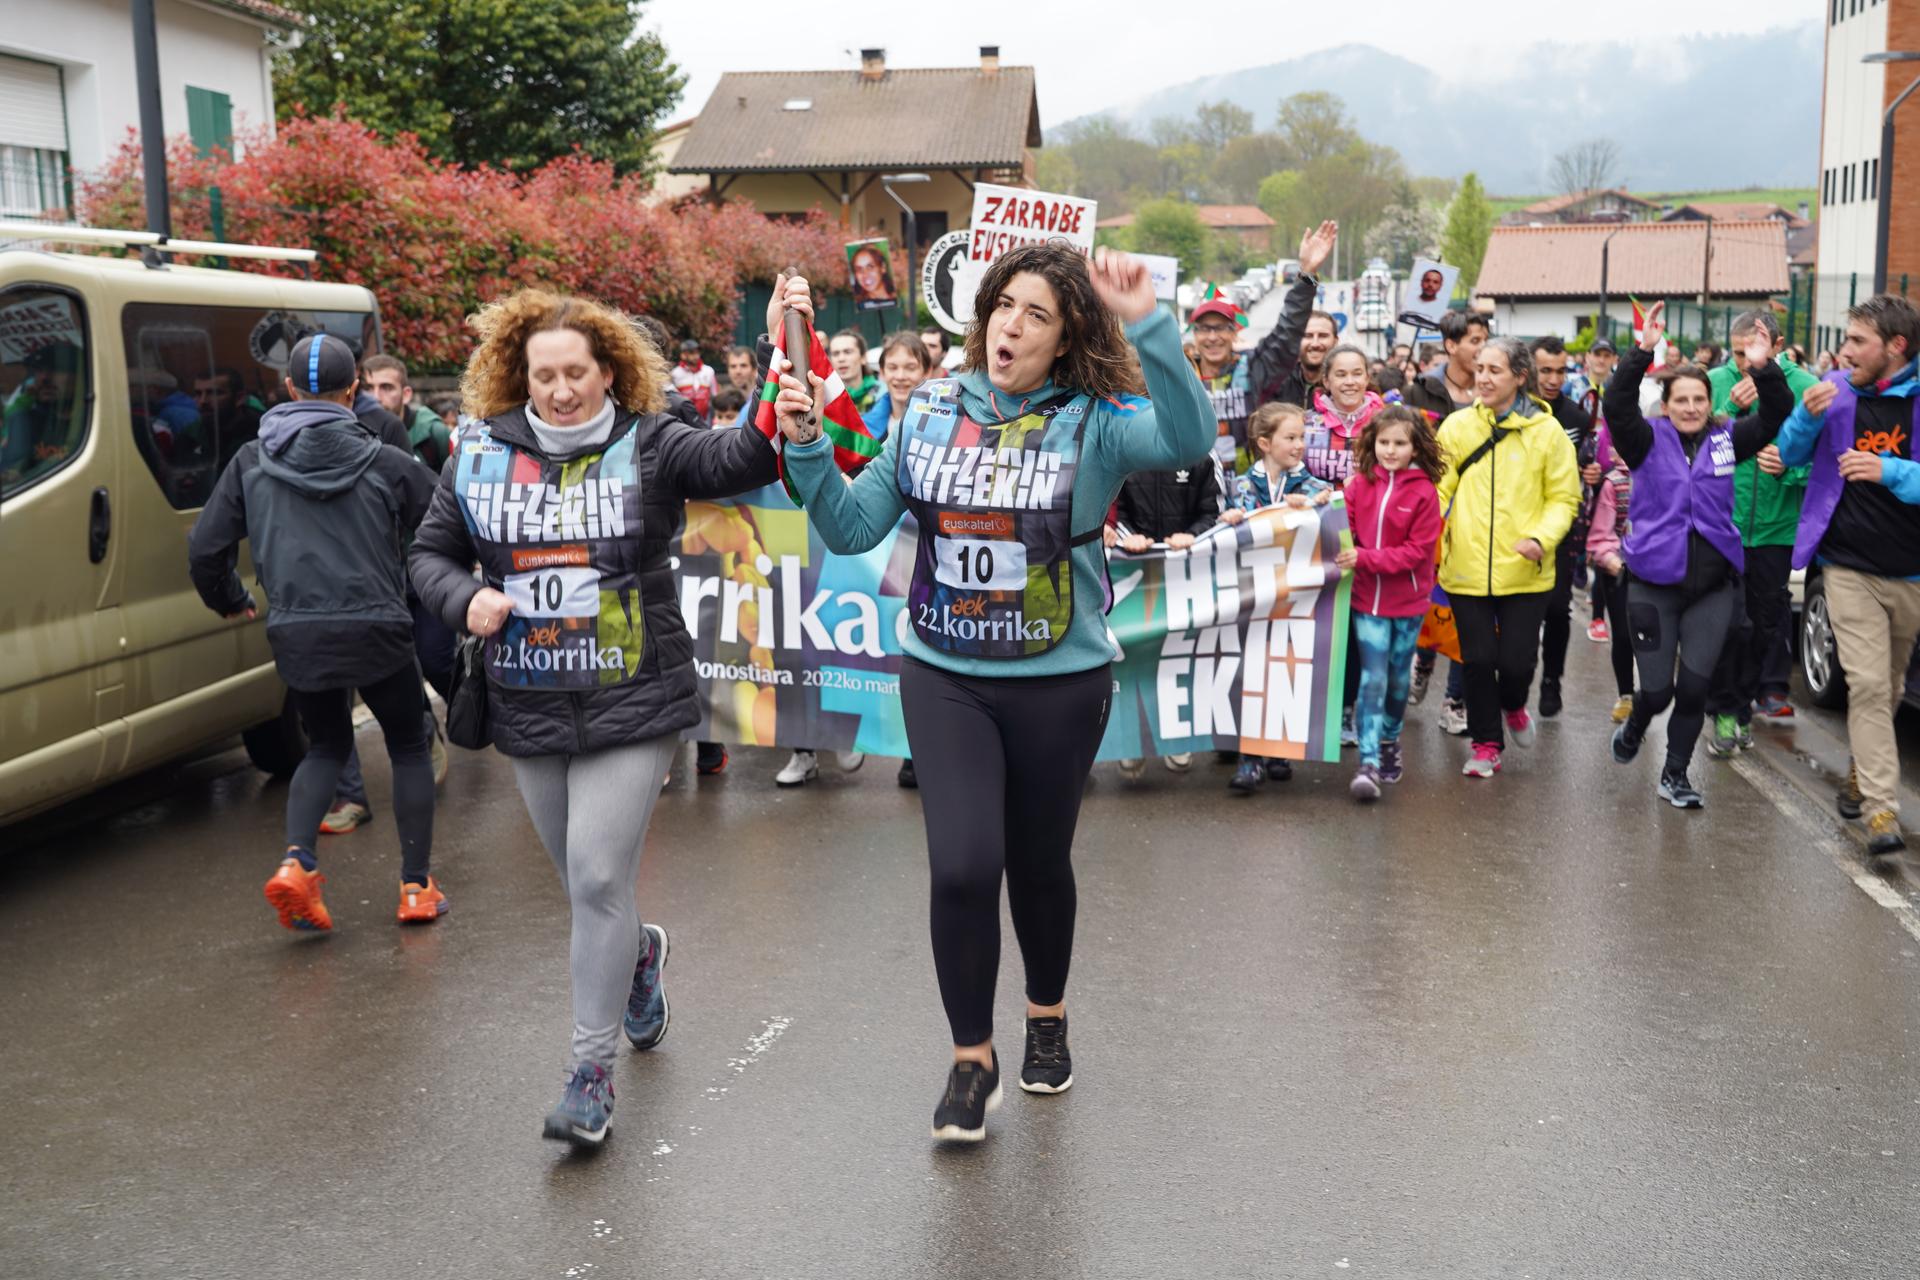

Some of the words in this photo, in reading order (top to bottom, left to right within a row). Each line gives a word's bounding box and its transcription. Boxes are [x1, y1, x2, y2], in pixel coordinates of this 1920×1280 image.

[981, 197, 1085, 233] ZARAOBE
[1856, 424, 1906, 456] aek
[943, 519, 995, 531] euskaltel
[518, 552, 568, 569] euskaltel
[957, 545, 994, 584] 10
[529, 574, 563, 612] 10
[681, 555, 886, 658] rrika
[951, 592, 987, 617] aek
[527, 621, 561, 647] aek
[917, 603, 1052, 641] 22.korrika
[493, 637, 625, 671] 22.korrika
[802, 670, 862, 691] 2022ko
[865, 679, 900, 696] mart
